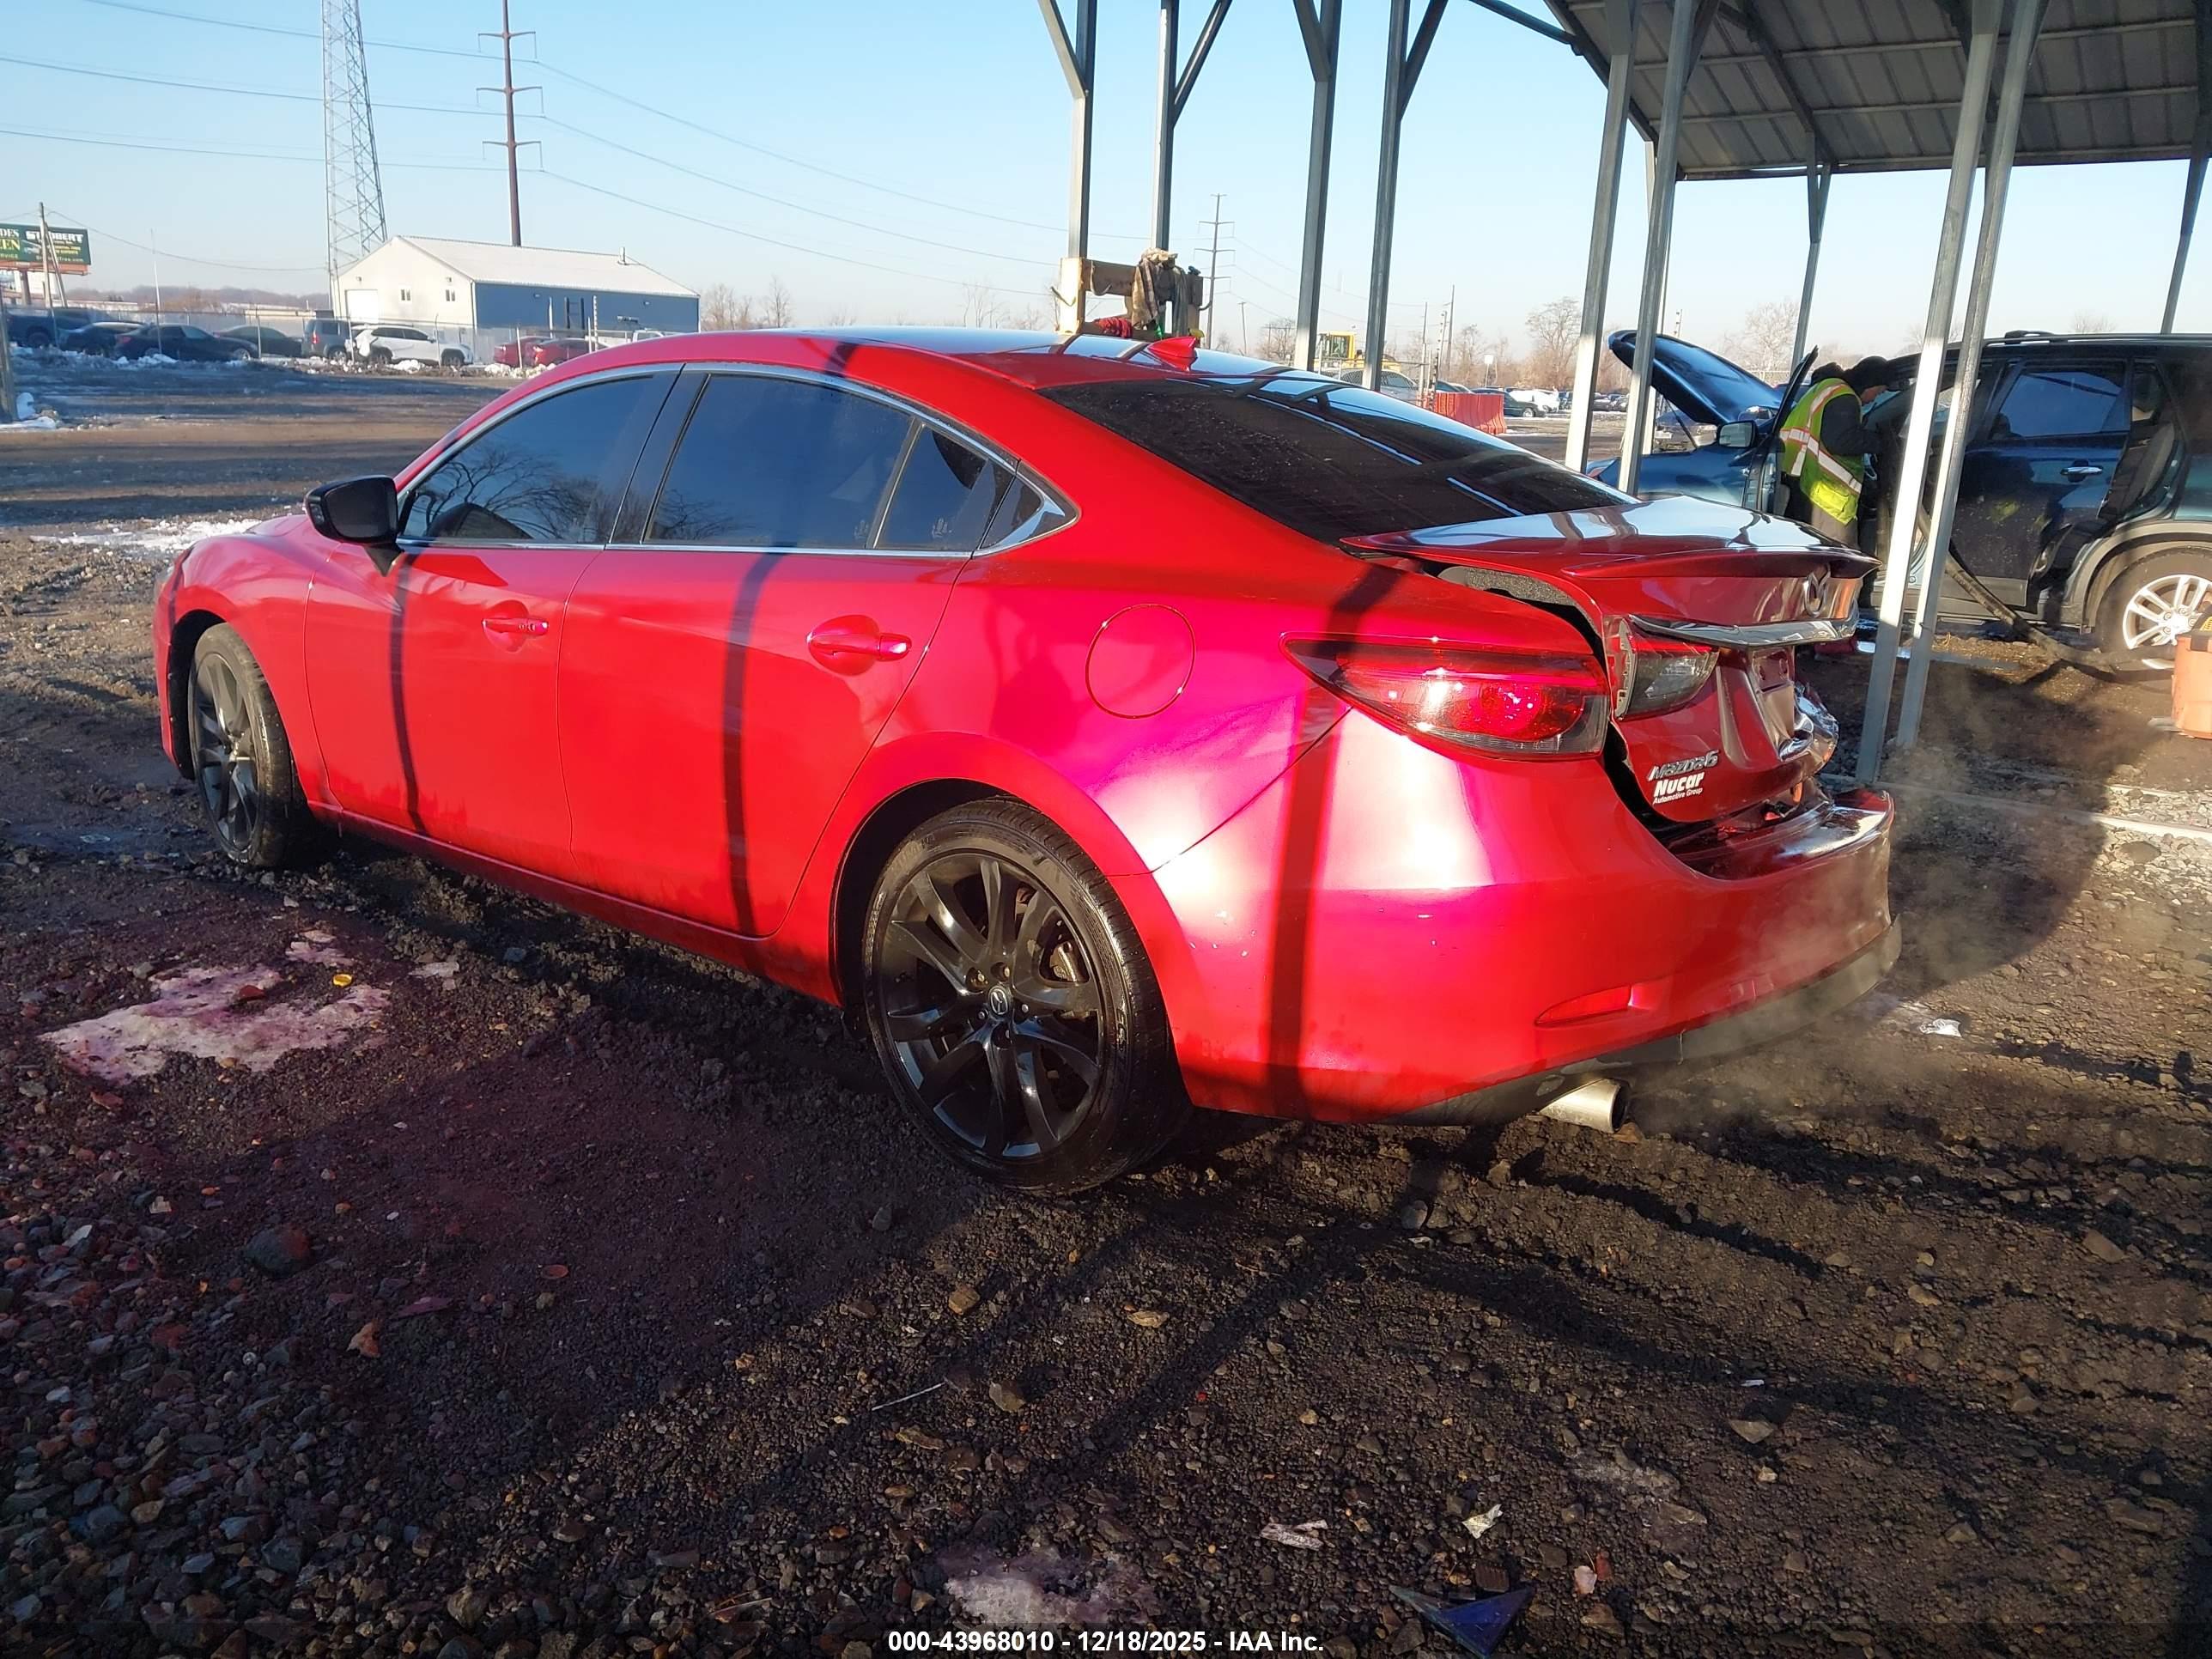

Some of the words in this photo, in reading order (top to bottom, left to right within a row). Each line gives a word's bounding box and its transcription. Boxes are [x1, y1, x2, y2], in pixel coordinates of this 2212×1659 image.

[26, 230, 83, 244] STBERT
[1652, 792, 1686, 805] Automotive
[1686, 787, 1703, 797] Group
